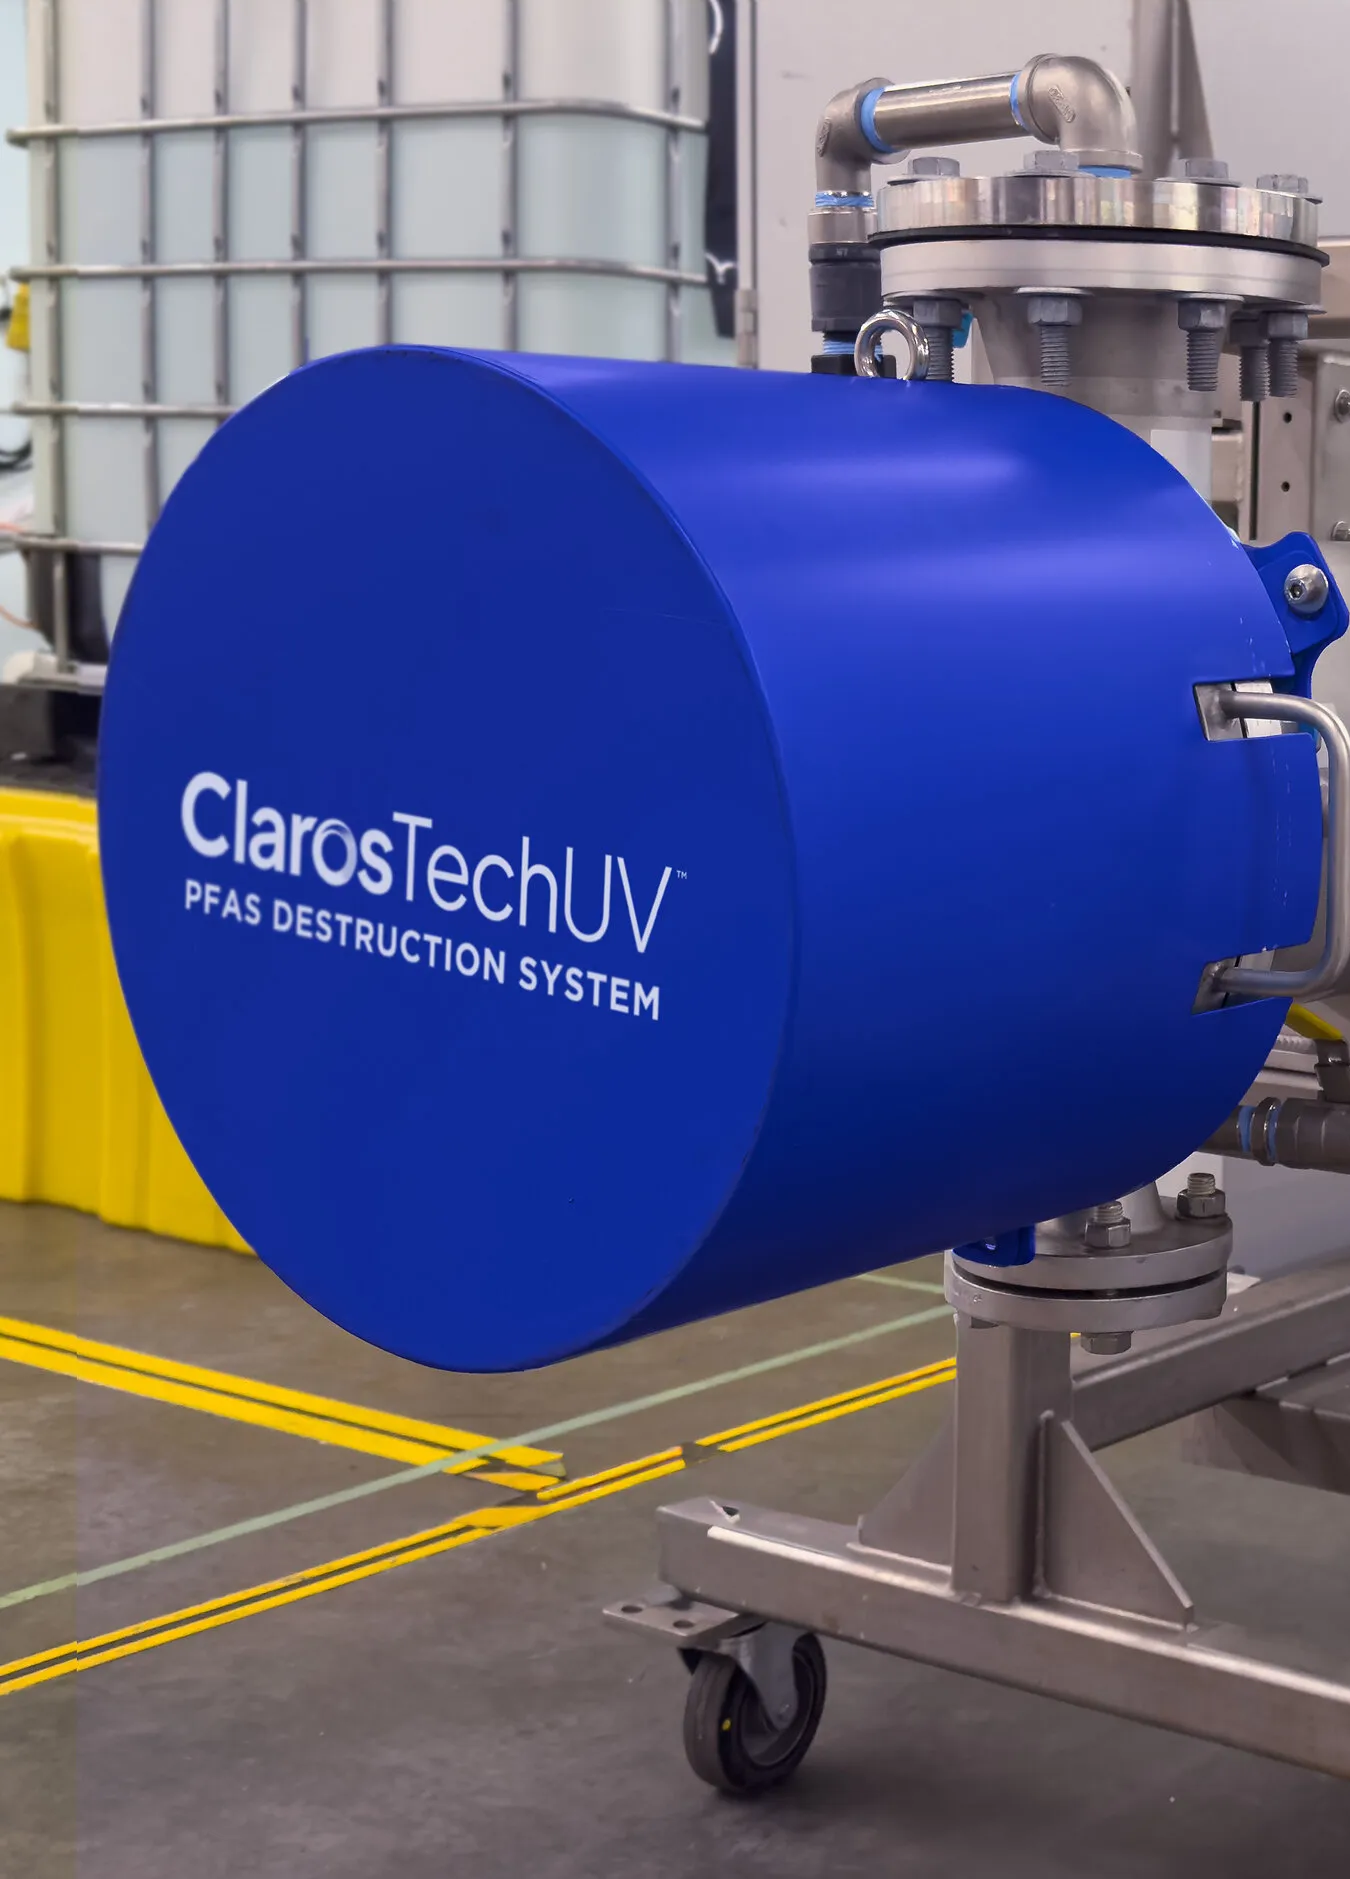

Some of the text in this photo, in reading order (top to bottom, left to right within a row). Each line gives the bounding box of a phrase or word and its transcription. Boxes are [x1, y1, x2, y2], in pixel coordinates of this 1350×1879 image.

[185, 879, 660, 1021] PFAS DESTRUCTION SYSTEM
